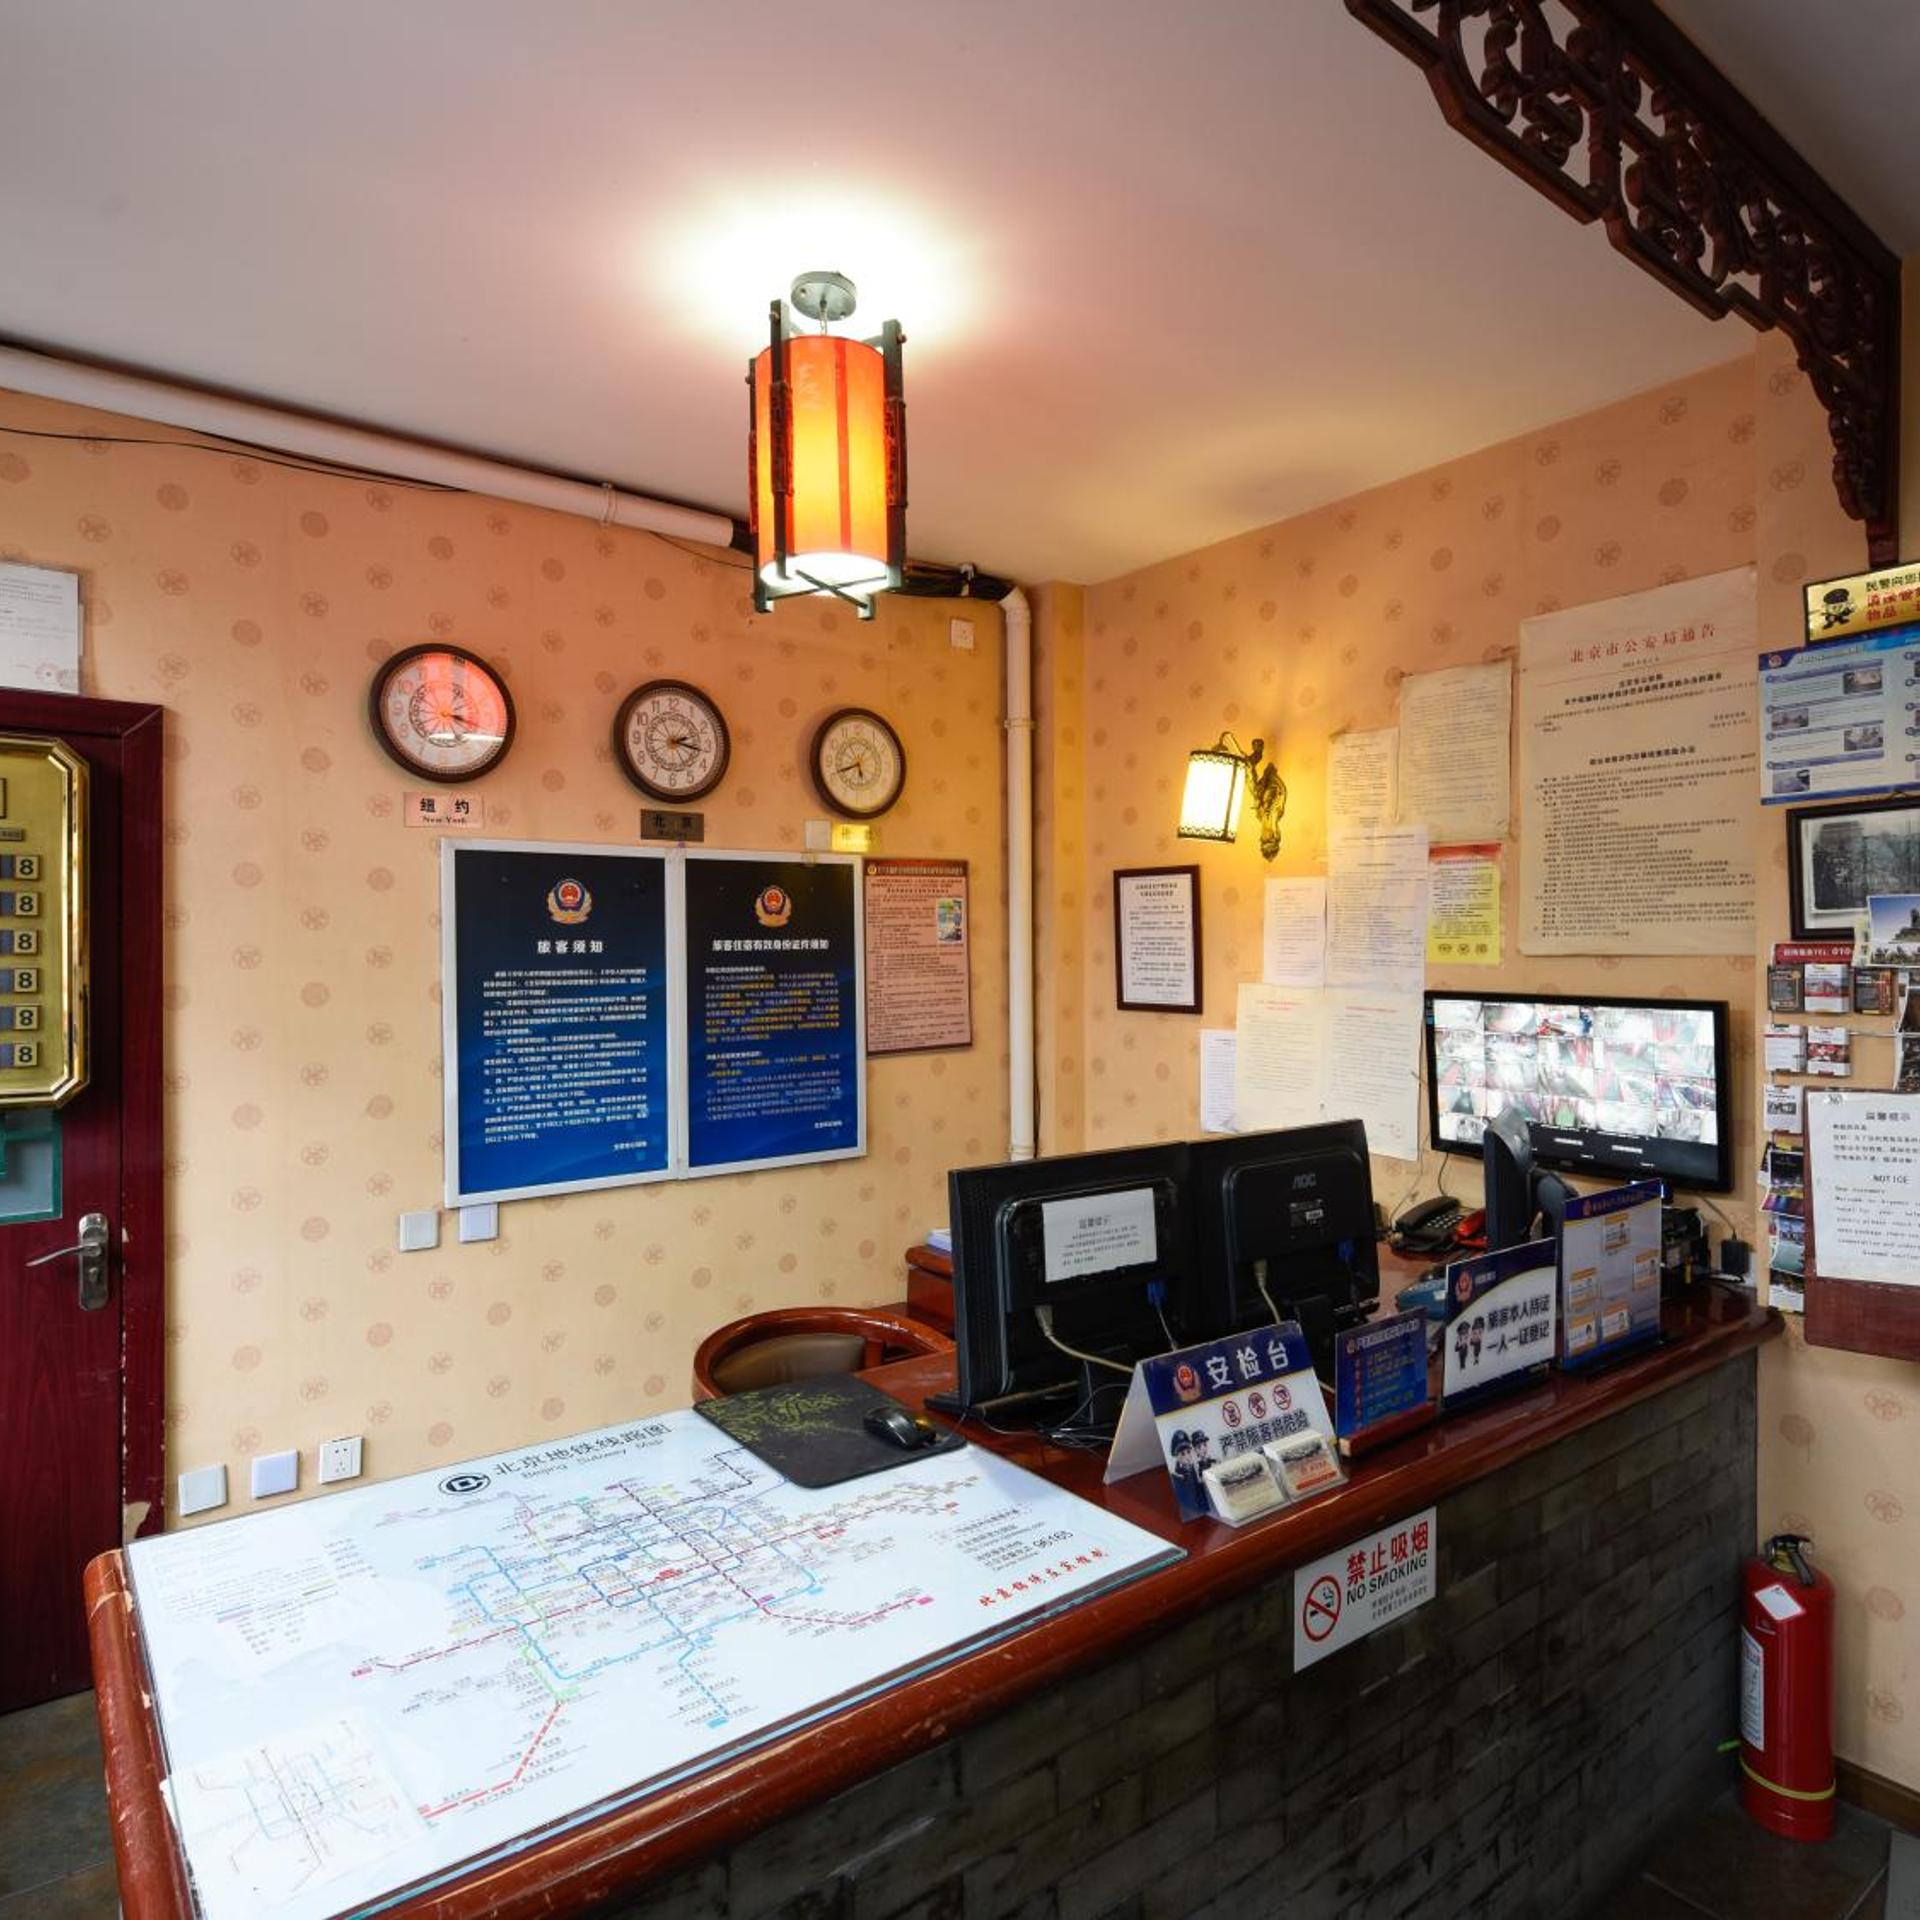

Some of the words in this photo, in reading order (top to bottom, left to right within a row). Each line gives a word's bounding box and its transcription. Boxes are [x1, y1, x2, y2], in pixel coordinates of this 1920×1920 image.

[1866, 571, 1920, 592] 民警向您
[1570, 624, 1718, 664] 北京市公安局通告
[419, 797, 470, 815] 纽约
[447, 816, 467, 824] York
[19, 859, 34, 876] 8
[19, 895, 34, 912] 8
[18, 933, 33, 950] 8
[537, 939, 603, 954] 旅客须知
[18, 971, 33, 989] 8
[19, 1009, 34, 1026] 8
[19, 1046, 33, 1063] 8
[1873, 1174, 1909, 1185] NOTICE
[1487, 1294, 1551, 1331] 旅客本人持证
[1487, 1320, 1550, 1353] 一人一证登记
[1206, 1340, 1289, 1390] 安检台
[494, 1424, 672, 1476] 北京地铁线路图
[1347, 1521, 1429, 1587] 禁止吸烟
[1347, 1583, 1366, 1605] NO
[1369, 1552, 1428, 1593] SMOKING
